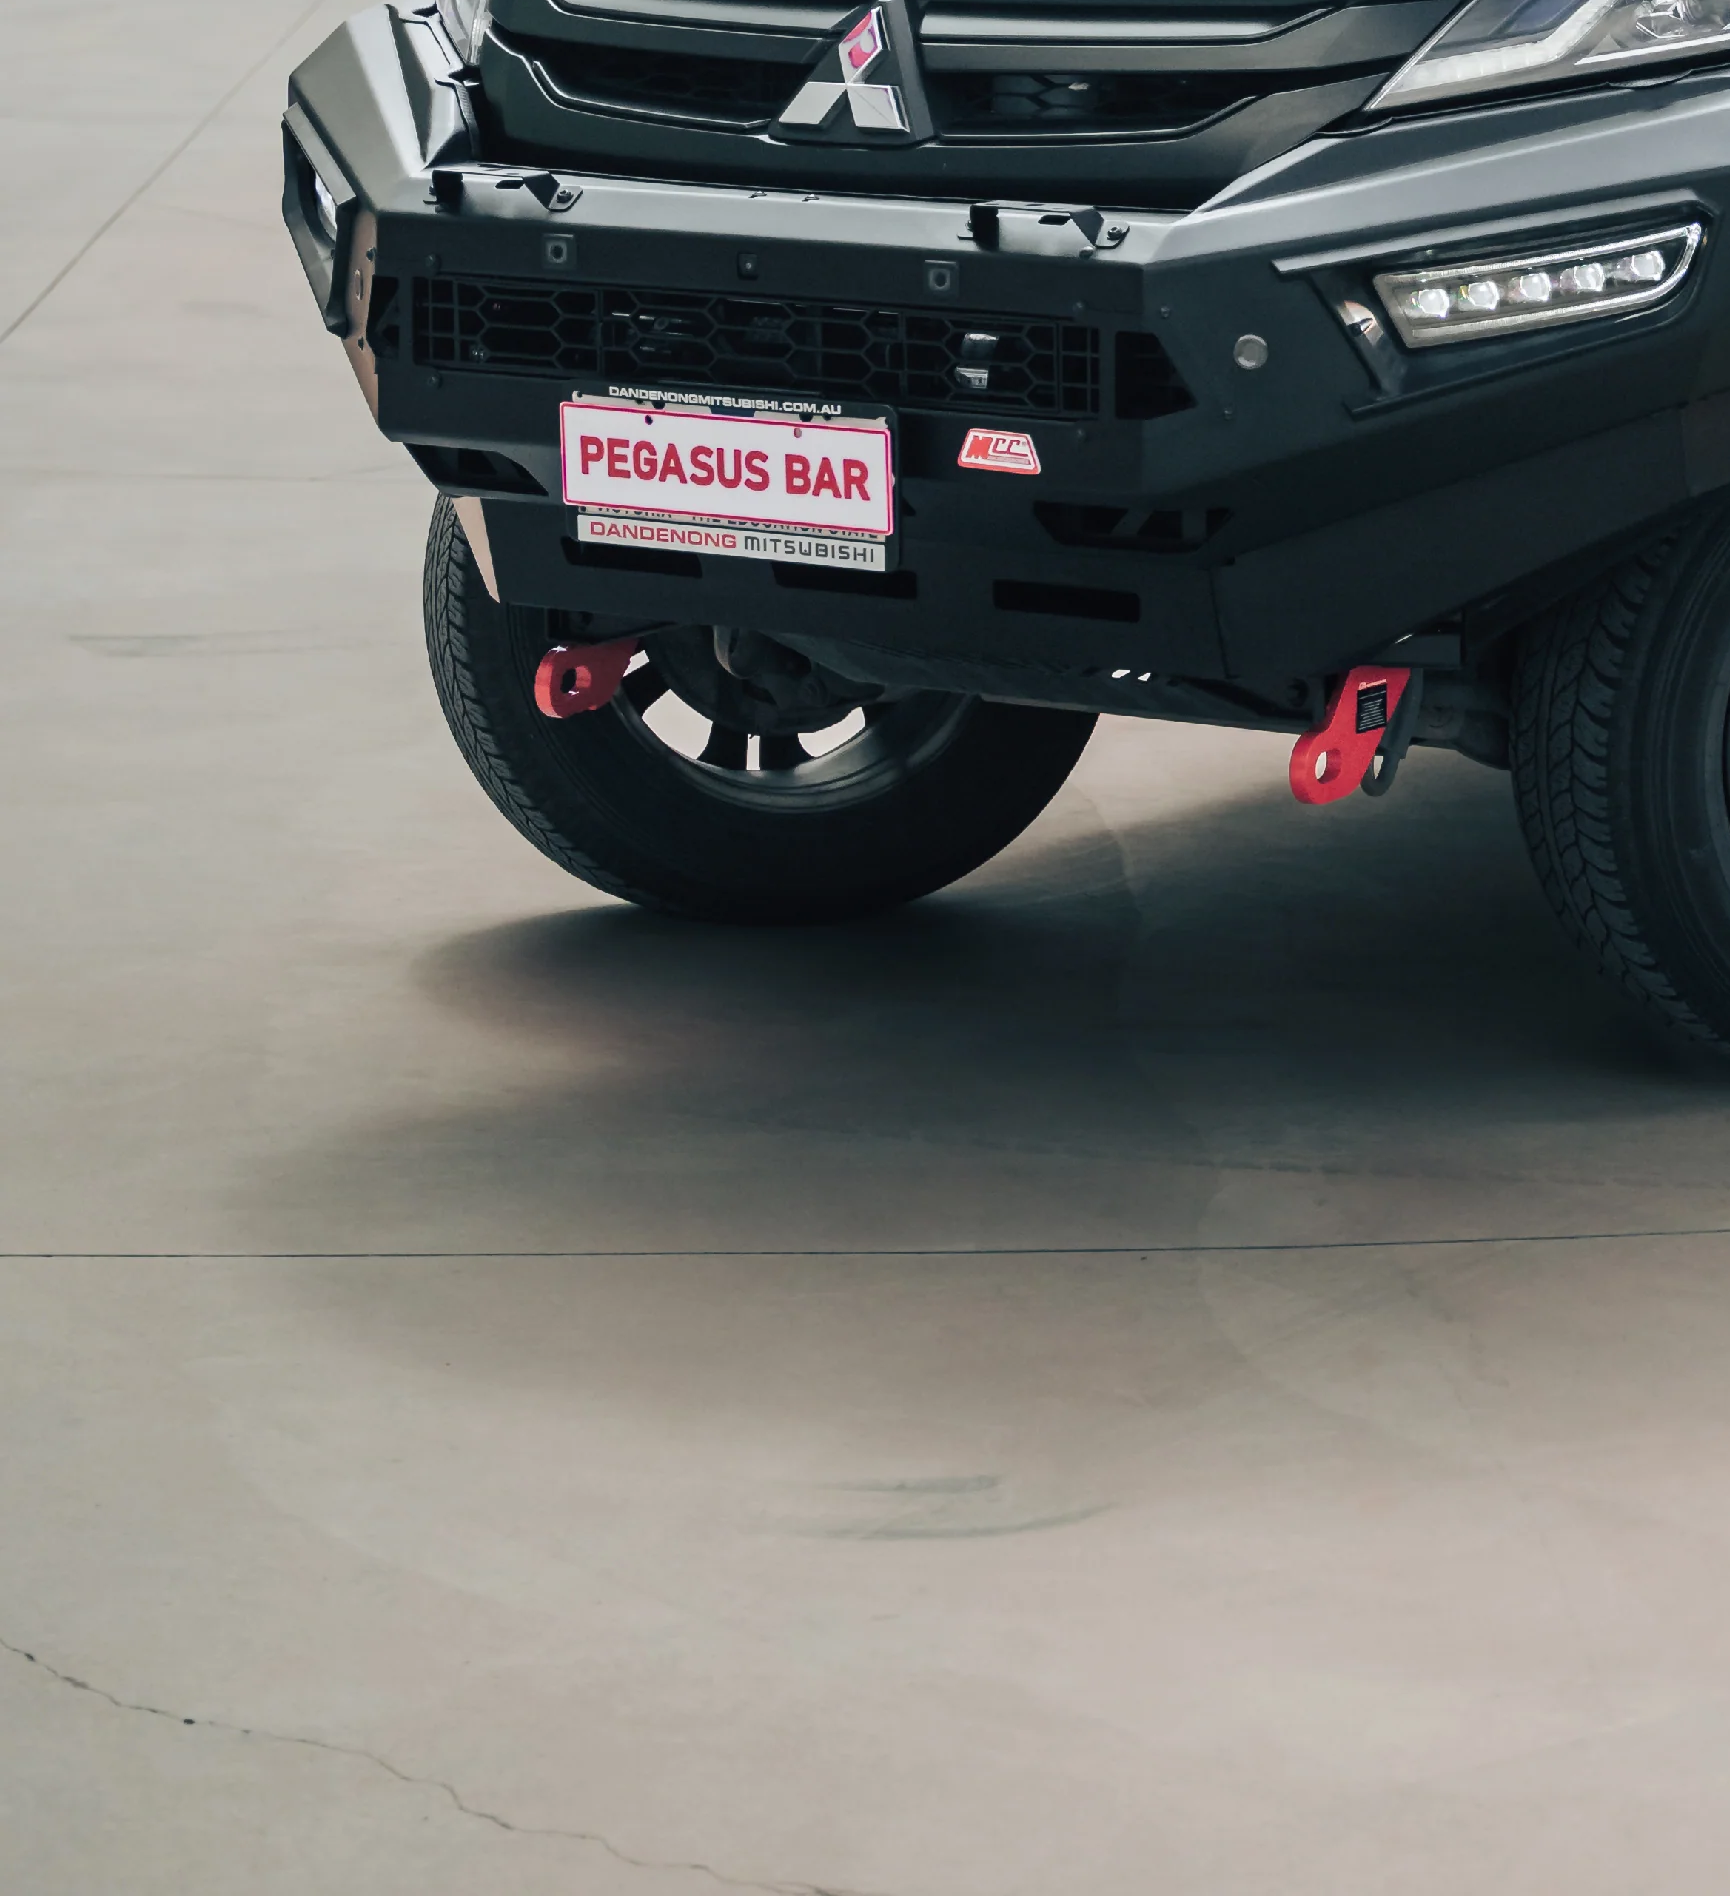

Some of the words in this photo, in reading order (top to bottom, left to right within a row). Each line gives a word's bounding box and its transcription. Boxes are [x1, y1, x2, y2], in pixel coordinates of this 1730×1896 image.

[608, 385, 842, 415] DANDENONGMITSUBISHI.COM.AU
[965, 435, 1028, 459] MCC
[580, 435, 770, 491] PEGASUS
[785, 453, 871, 501] BAR
[590, 521, 737, 549] DANDENONG
[744, 535, 875, 563] MITSUBISHI
